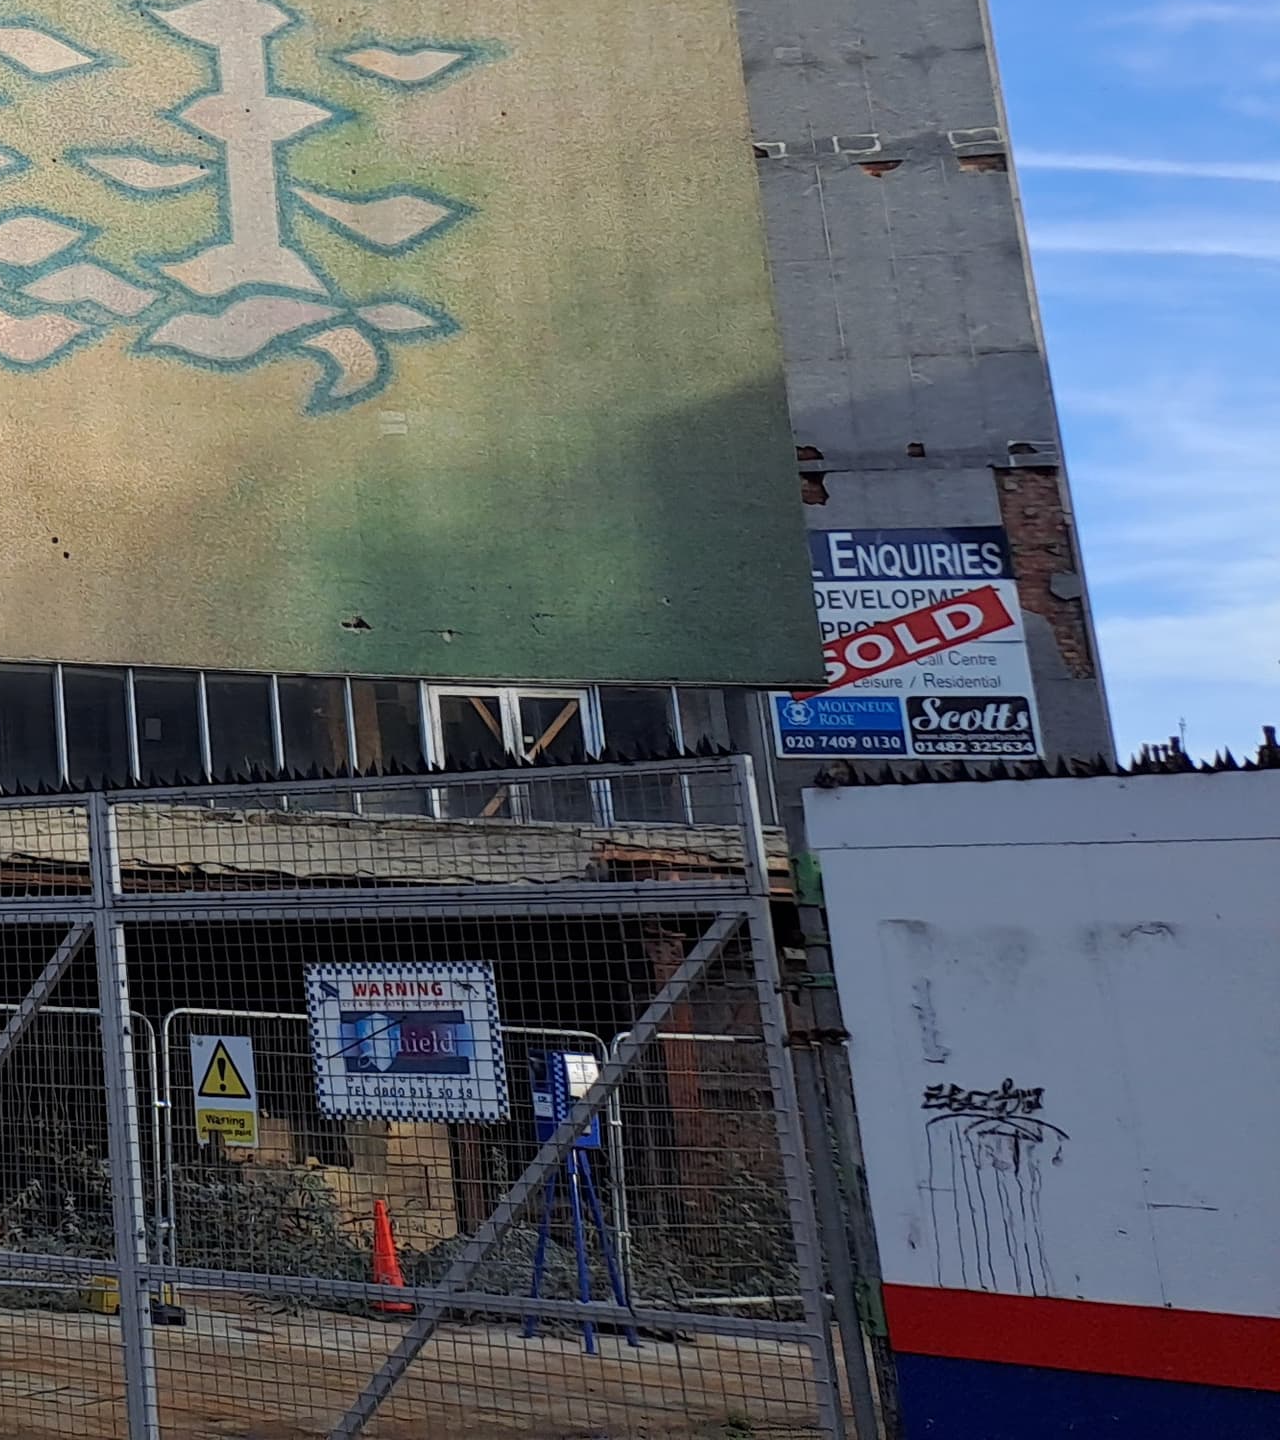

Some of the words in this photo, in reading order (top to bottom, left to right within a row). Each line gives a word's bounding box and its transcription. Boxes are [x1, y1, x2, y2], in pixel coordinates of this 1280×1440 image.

[948, 650, 997, 666] Centre
[923, 672, 1001, 688] Residential
[818, 700, 896, 713] MOLYNEUX
[820, 715, 855, 726] ROSE
[912, 698, 1029, 732] Scotts
[786, 735, 815, 749] 020
[820, 735, 857, 749] 7409
[862, 735, 902, 749] 0130
[914, 741, 967, 753] 01482
[969, 741, 1035, 753] 325634
[352, 982, 444, 997] WARNING
